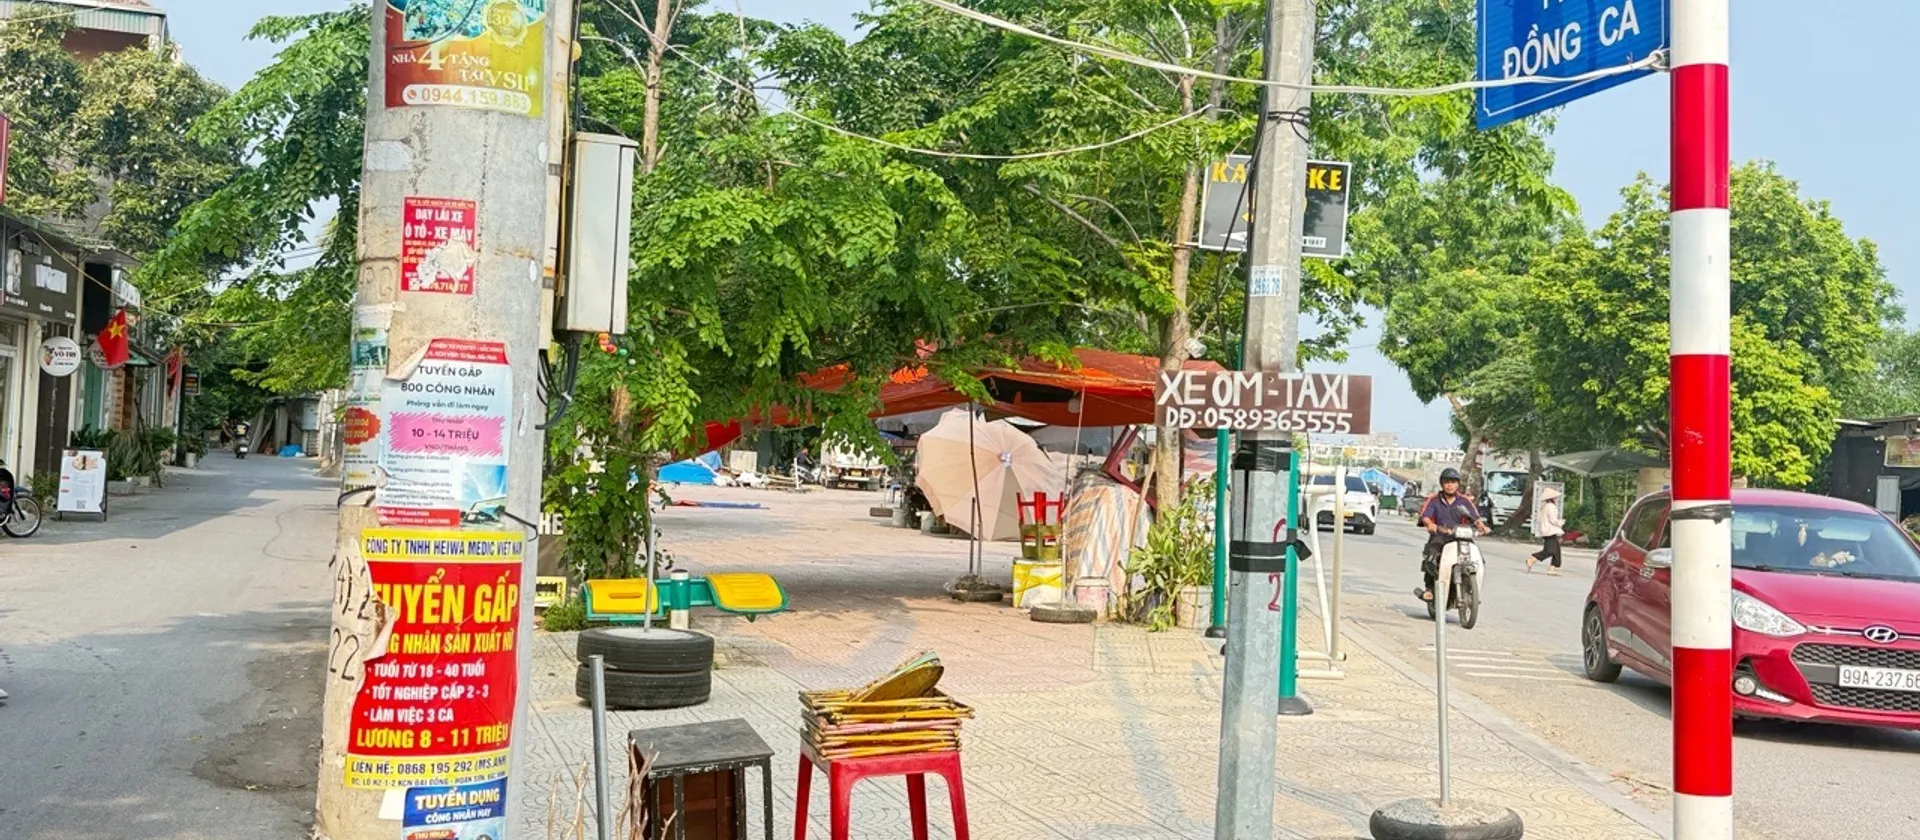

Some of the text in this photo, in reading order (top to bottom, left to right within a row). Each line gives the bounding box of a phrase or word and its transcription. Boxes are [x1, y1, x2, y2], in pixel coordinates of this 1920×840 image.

[1502, 0, 1640, 80] ĐỒNG CA
[392, 50, 417, 65] NHÀ
[418, 42, 449, 71] 4
[451, 210, 464, 223] XE
[405, 222, 413, 238] Ô
[434, 226, 449, 240] XE
[401, 381, 496, 397] 800 CÔNG NHÂN
[1157, 370, 1207, 406] XE
[1277, 372, 1349, 411] TAXI
[411, 428, 424, 439] 10
[433, 430, 446, 440] 14
[448, 428, 480, 444] TRIỆU
[366, 536, 388, 554] CÔNG
[391, 539, 402, 554] TY
[405, 540, 430, 555] TNHH
[433, 540, 465, 555] HEIWA
[468, 541, 494, 556] MEDIC
[473, 570, 519, 624] GẤP
[473, 626, 503, 655] XUẤT
[419, 664, 433, 679] 18
[444, 664, 459, 679] 40
[371, 684, 391, 701] TỐT
[393, 683, 438, 704] NGHIỆP
[440, 681, 465, 701] CẤP
[466, 686, 474, 699] 2
[482, 685, 489, 699] 3
[369, 705, 455, 726] LÀM VIỆC 3 CA
[356, 727, 415, 752] LƯƠNG
[419, 730, 432, 749] 8
[450, 728, 468, 747] 11
[475, 722, 510, 748] TRIỆU
[351, 760, 374, 774] LIÊN
[397, 763, 426, 775] 0868
[430, 763, 450, 774] 195
[453, 760, 472, 773] 292
[469, 787, 501, 807] DỤNG
[425, 807, 493, 824] CÔNG NHÂN MAY
[415, 831, 431, 840] THU
